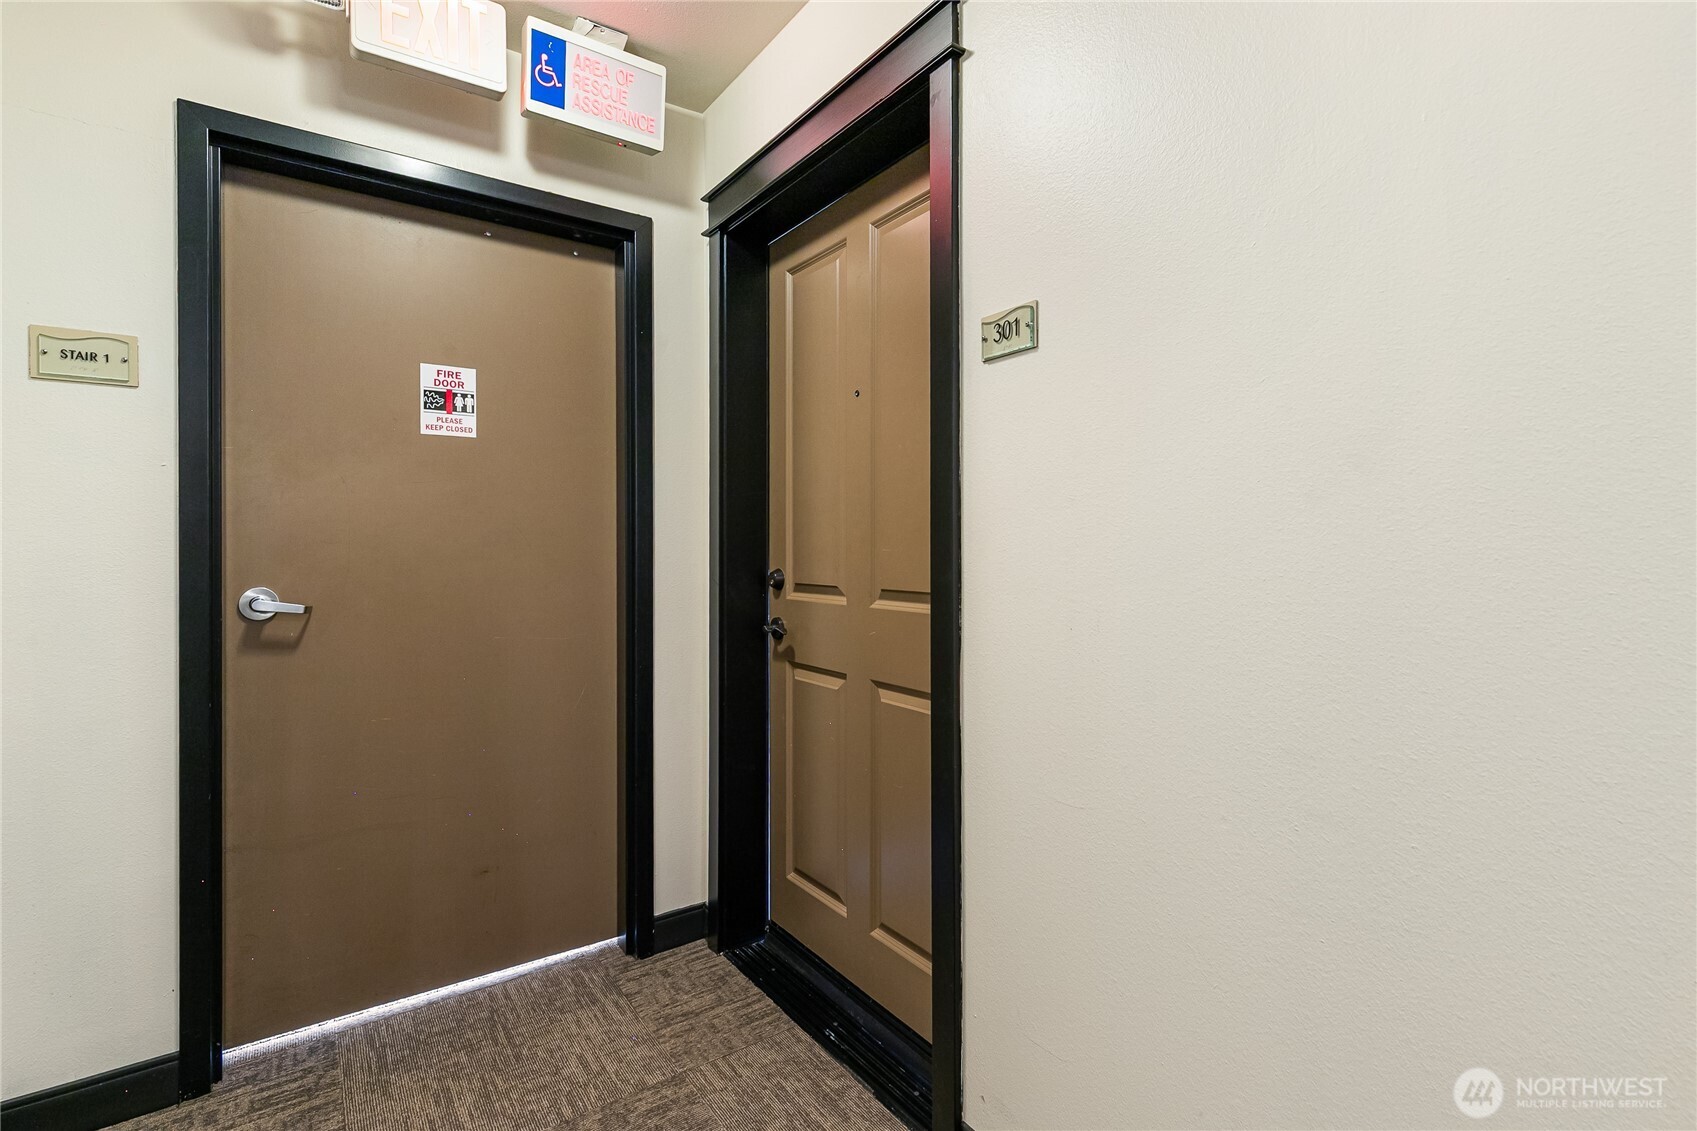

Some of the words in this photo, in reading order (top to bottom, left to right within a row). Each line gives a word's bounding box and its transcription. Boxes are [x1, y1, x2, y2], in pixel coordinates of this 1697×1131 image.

[380, 0, 488, 71] EXIT
[573, 53, 611, 82] AREA
[615, 68, 635, 88] OF
[572, 72, 628, 107] RESCUE
[572, 92, 656, 134] ASSISTANCE
[993, 317, 1018, 343] 301
[60, 348, 98, 362] STAIR
[103, 353, 110, 363] 1
[433, 378, 465, 389] DOOR
[436, 369, 462, 380] FIRE
[425, 423, 444, 431] KEEP
[445, 425, 473, 434] CLOSED
[436, 416, 463, 425] PLEASE
